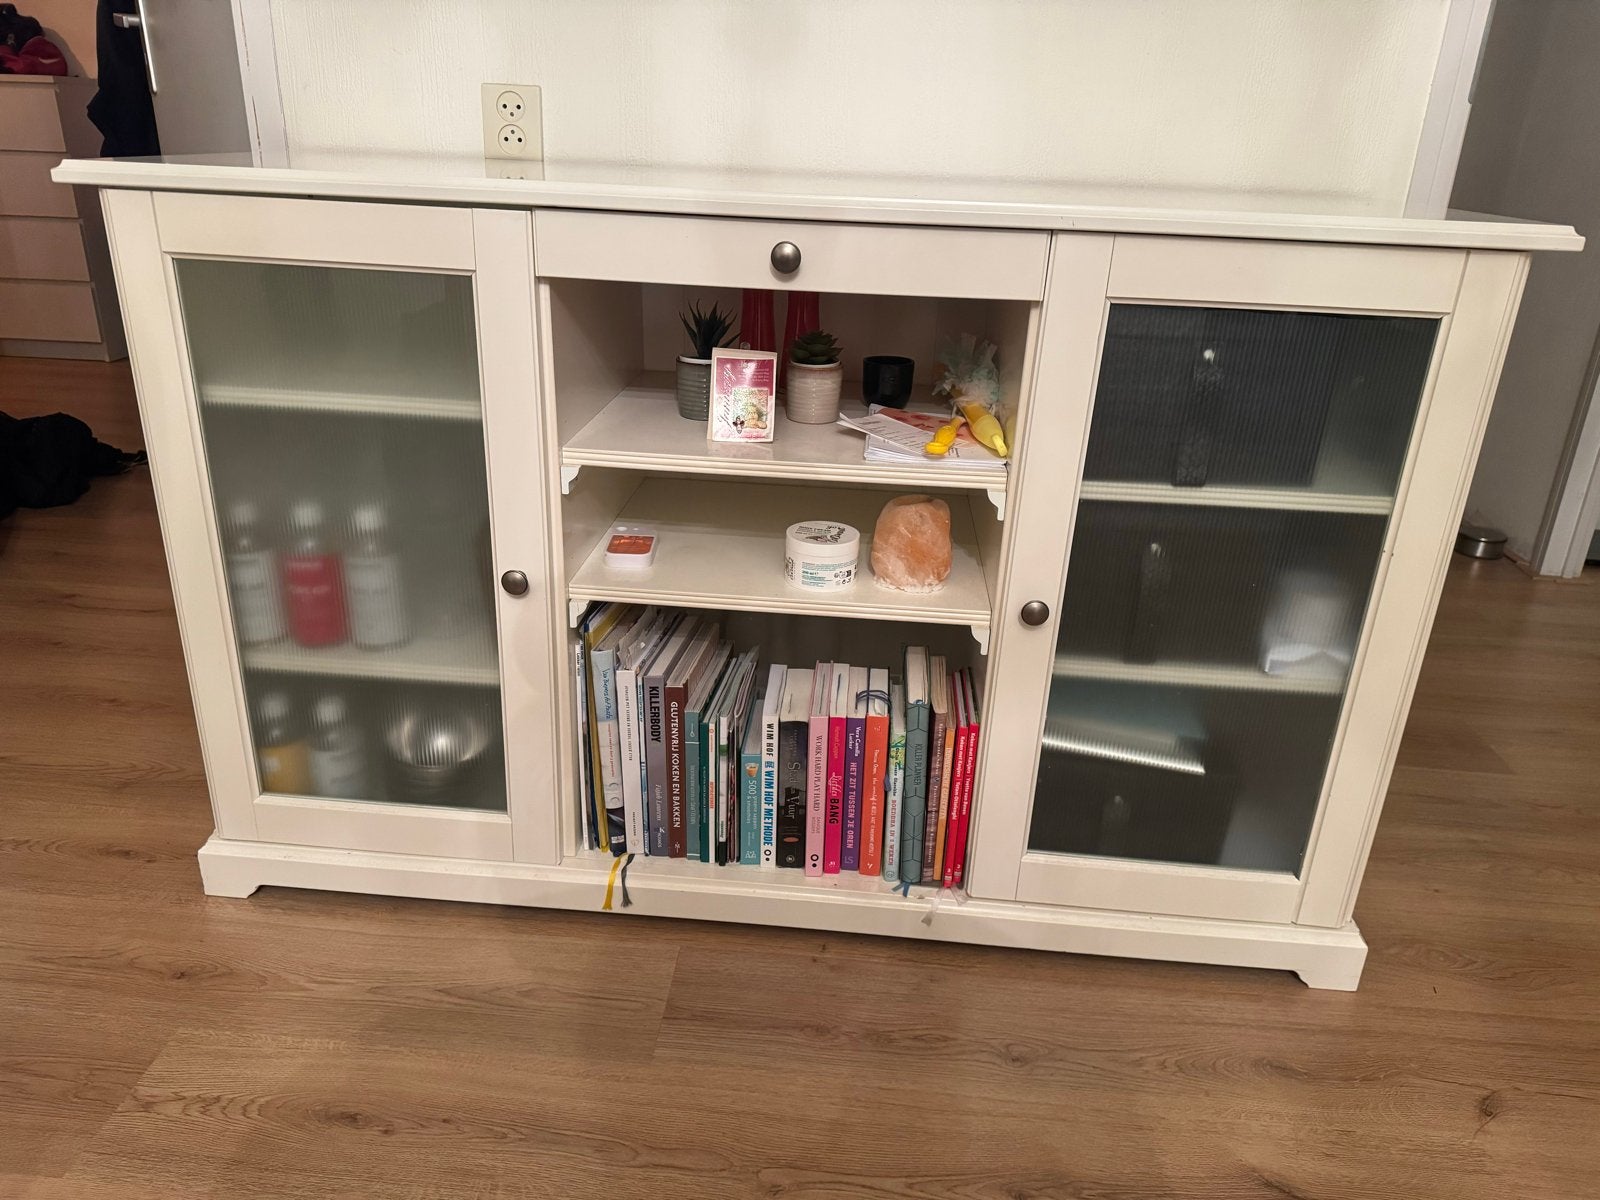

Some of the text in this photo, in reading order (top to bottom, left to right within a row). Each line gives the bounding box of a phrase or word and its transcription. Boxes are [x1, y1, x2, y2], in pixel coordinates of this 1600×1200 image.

[649, 686, 661, 742] KILLERBODY
[915, 743, 923, 761] KILLER
[670, 702, 680, 827] GLUTENVRIJ KOKEN EN BAKKEN
[748, 780, 757, 794] 500
[765, 770, 774, 789] WIM
[764, 791, 774, 806] HOF
[847, 791, 856, 817] TUSSEN
[829, 799, 839, 824] BANG
[764, 808, 774, 846] METHODE
[847, 819, 854, 828] JE
[846, 830, 854, 848] OREN
